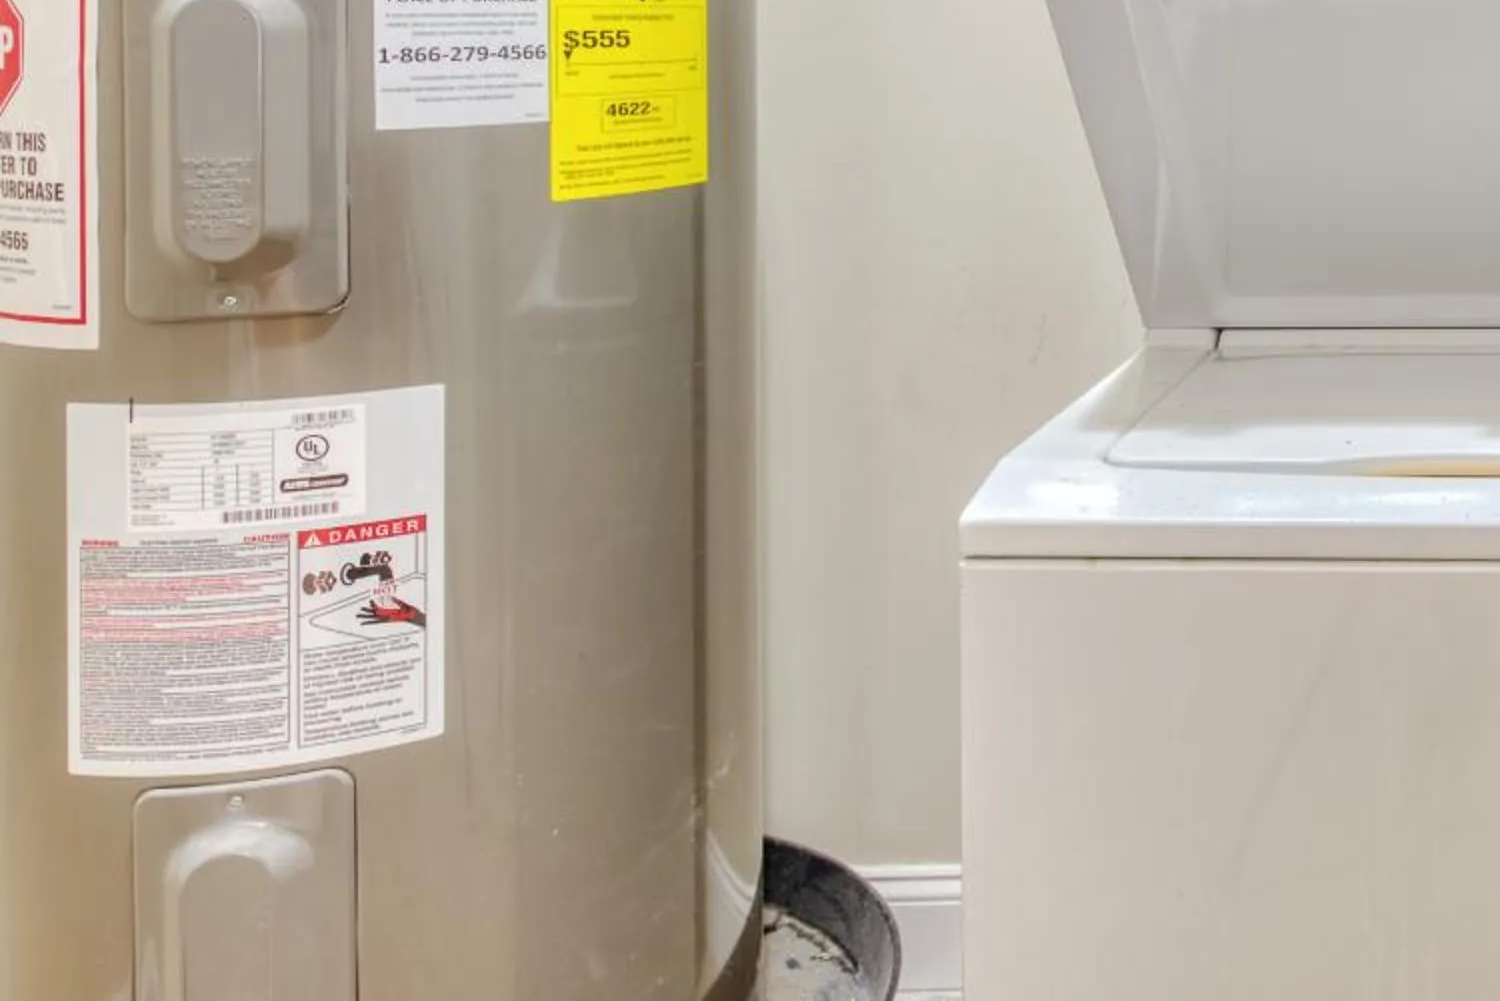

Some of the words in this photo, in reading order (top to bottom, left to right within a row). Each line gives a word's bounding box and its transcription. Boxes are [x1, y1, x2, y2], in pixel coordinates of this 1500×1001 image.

[563, 30, 632, 50] $555
[379, 44, 548, 65] 1-866-279-4566
[606, 102, 651, 118] 4622
[15, 132, 47, 152] THIS
[21, 156, 38, 177] TO
[0, 180, 65, 202] URCHASE
[328, 518, 420, 544] DANGER
